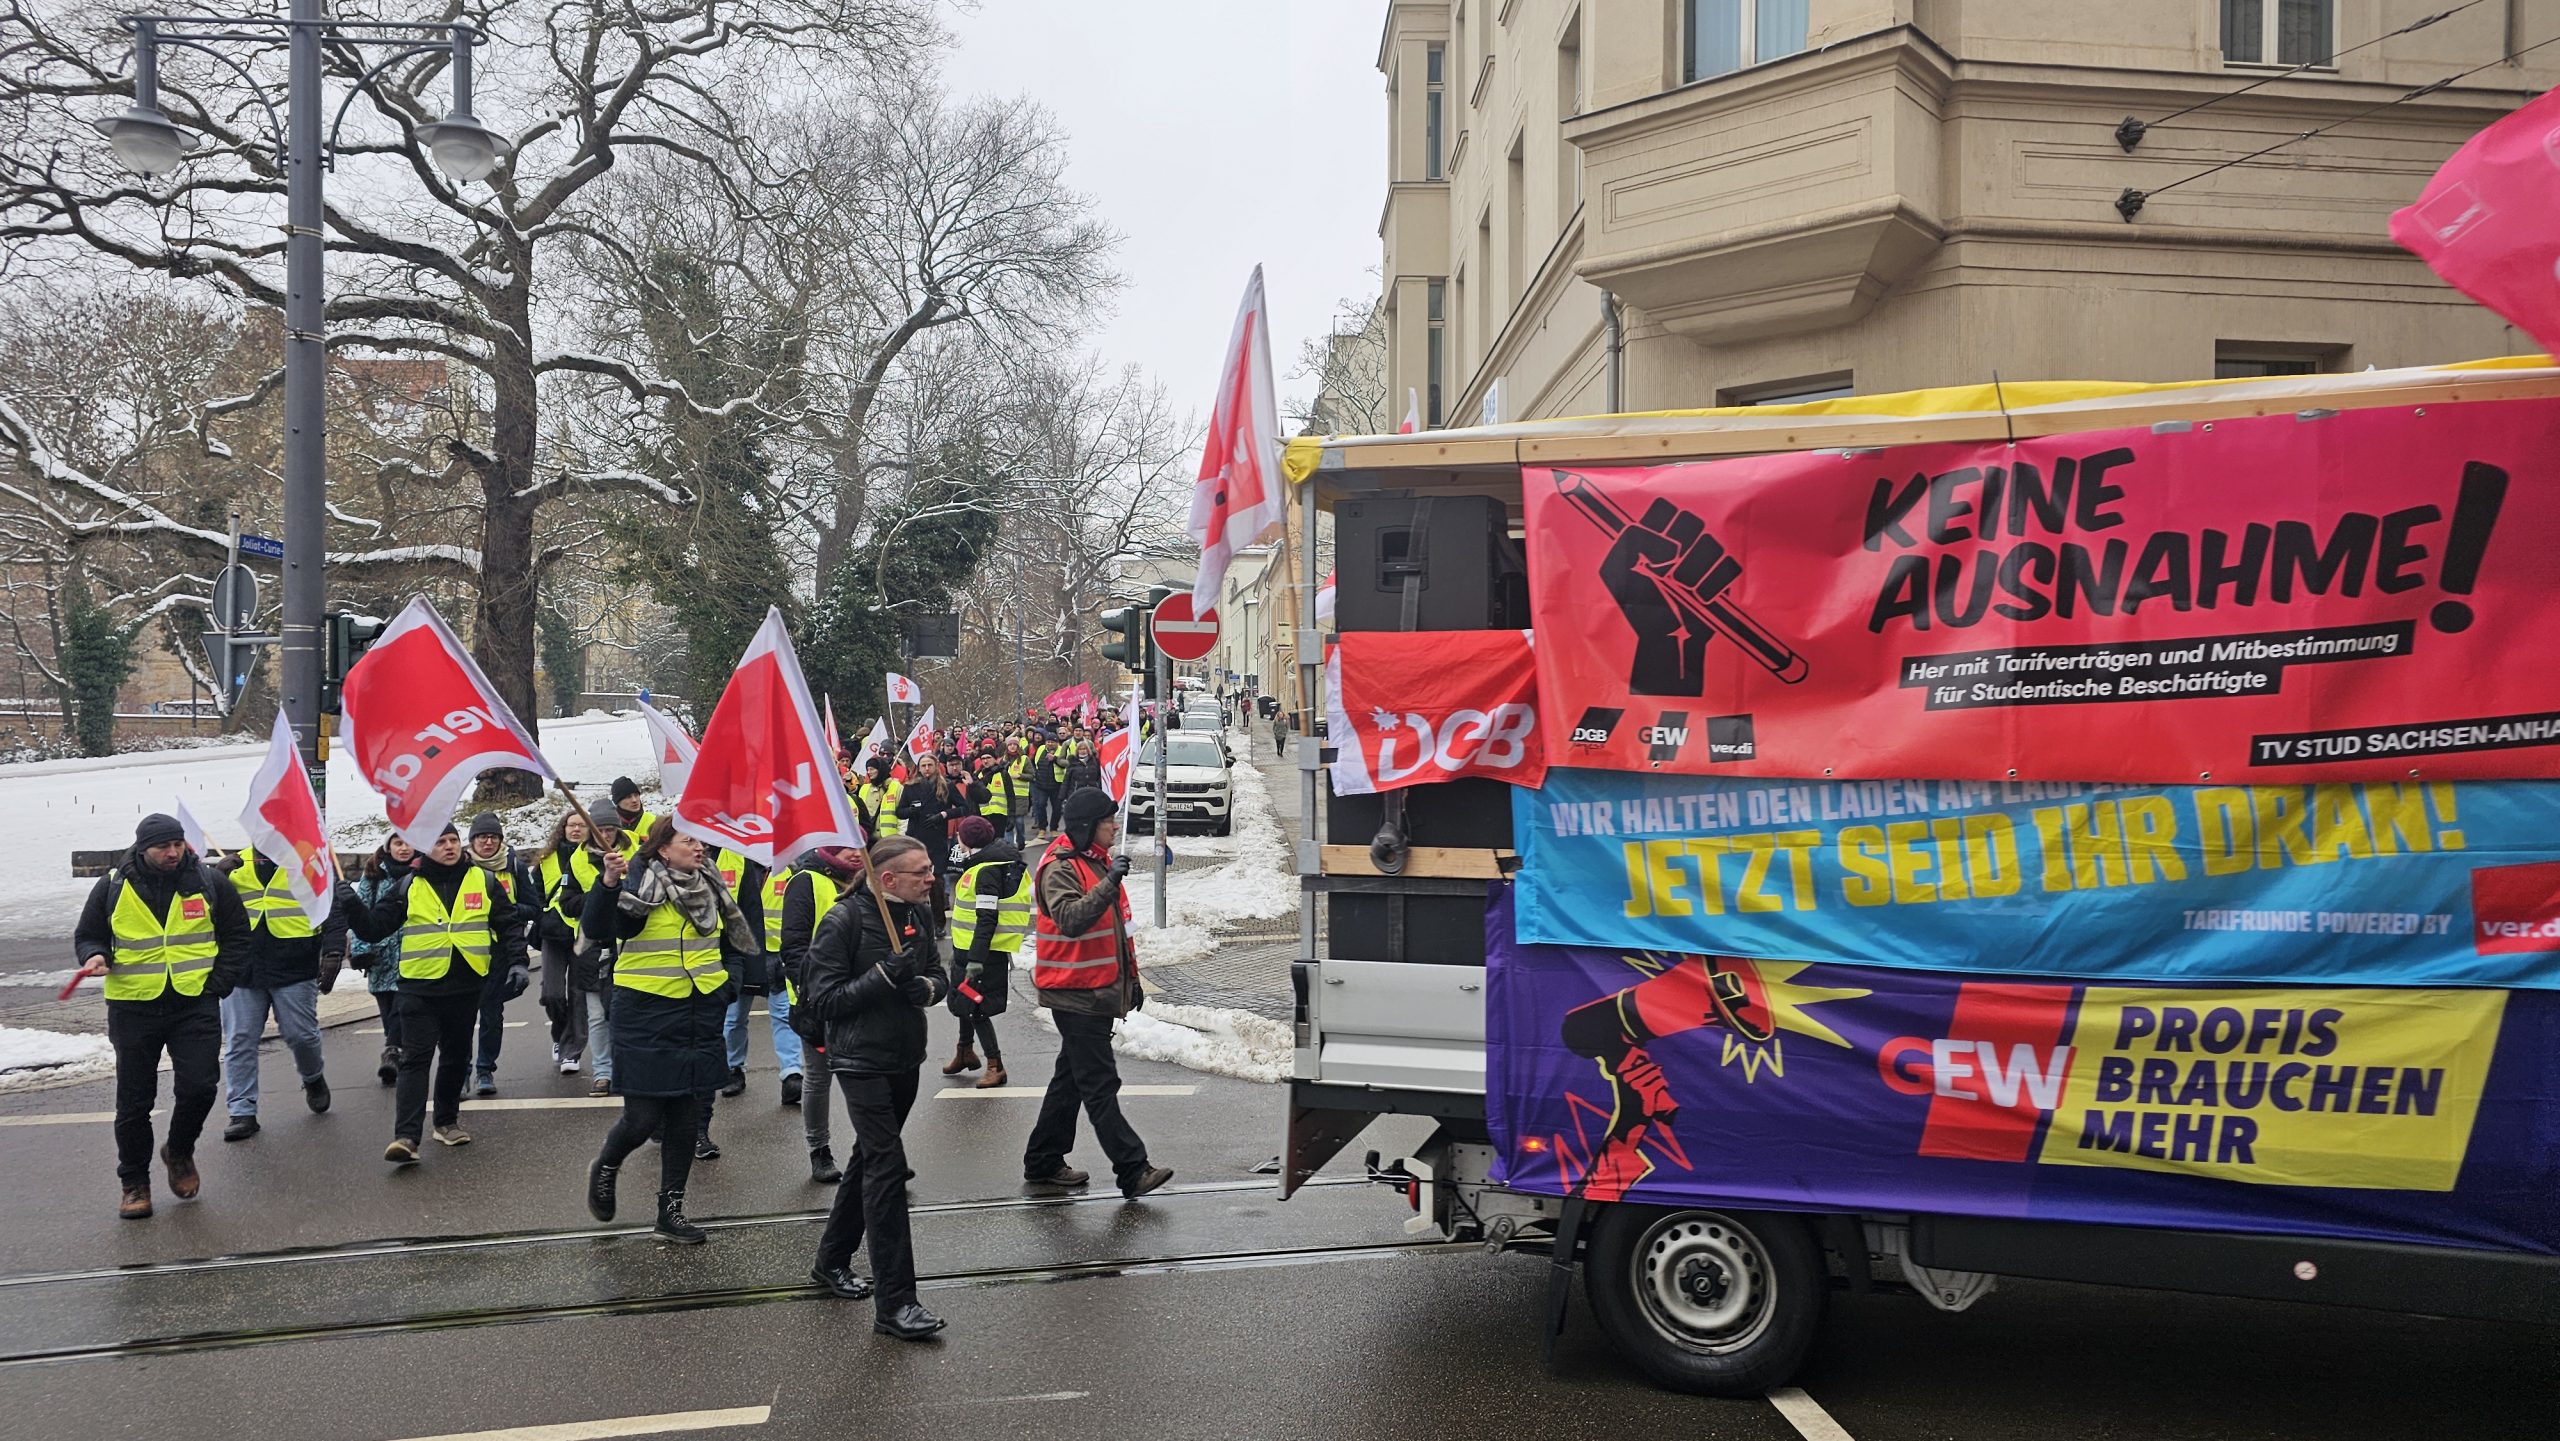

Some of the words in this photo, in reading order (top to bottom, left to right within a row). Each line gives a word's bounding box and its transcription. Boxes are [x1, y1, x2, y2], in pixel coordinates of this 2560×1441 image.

[1863, 447, 2135, 552] KEINE
[1868, 460, 2509, 634] AUSNAHME!
[1909, 663, 1948, 681] Her
[1953, 657, 1989, 677] mit
[1995, 650, 2153, 673] Tarifverträgen
[2159, 643, 2205, 666] und
[2210, 633, 2400, 662] Mitbestimmung
[1934, 685, 1966, 704] für
[1971, 678, 2112, 702] Studentische
[2118, 670, 2268, 696] Beschäftigte
[1369, 703, 1536, 782] DGB
[1573, 727, 1607, 742] DGB
[1638, 726, 1689, 746] GEW
[1710, 742, 1753, 755] ver.di
[2258, 741, 2292, 760] TV
[2295, 736, 2361, 758] STUD
[1550, 801, 1615, 837] WIR
[1621, 792, 1740, 834] HALTEN
[1748, 786, 1812, 826] DEN
[1820, 780, 1929, 820] LADEN
[1938, 781, 1993, 811] AM
[1622, 829, 1822, 918] JETZT
[1838, 813, 2020, 907] SEID
[2031, 794, 2188, 893] IHR
[2193, 781, 2466, 877] DRAN!
[2183, 909, 2312, 933] TARIFRUNDE
[2317, 911, 2419, 936] POWERED
[2422, 913, 2453, 936] BY
[2113, 1006, 2345, 1058] PROFIS
[1877, 1036, 2078, 1111] GEW
[2094, 1056, 2446, 1117] BRAUCHEN
[2077, 1108, 2260, 1165] MEHR
